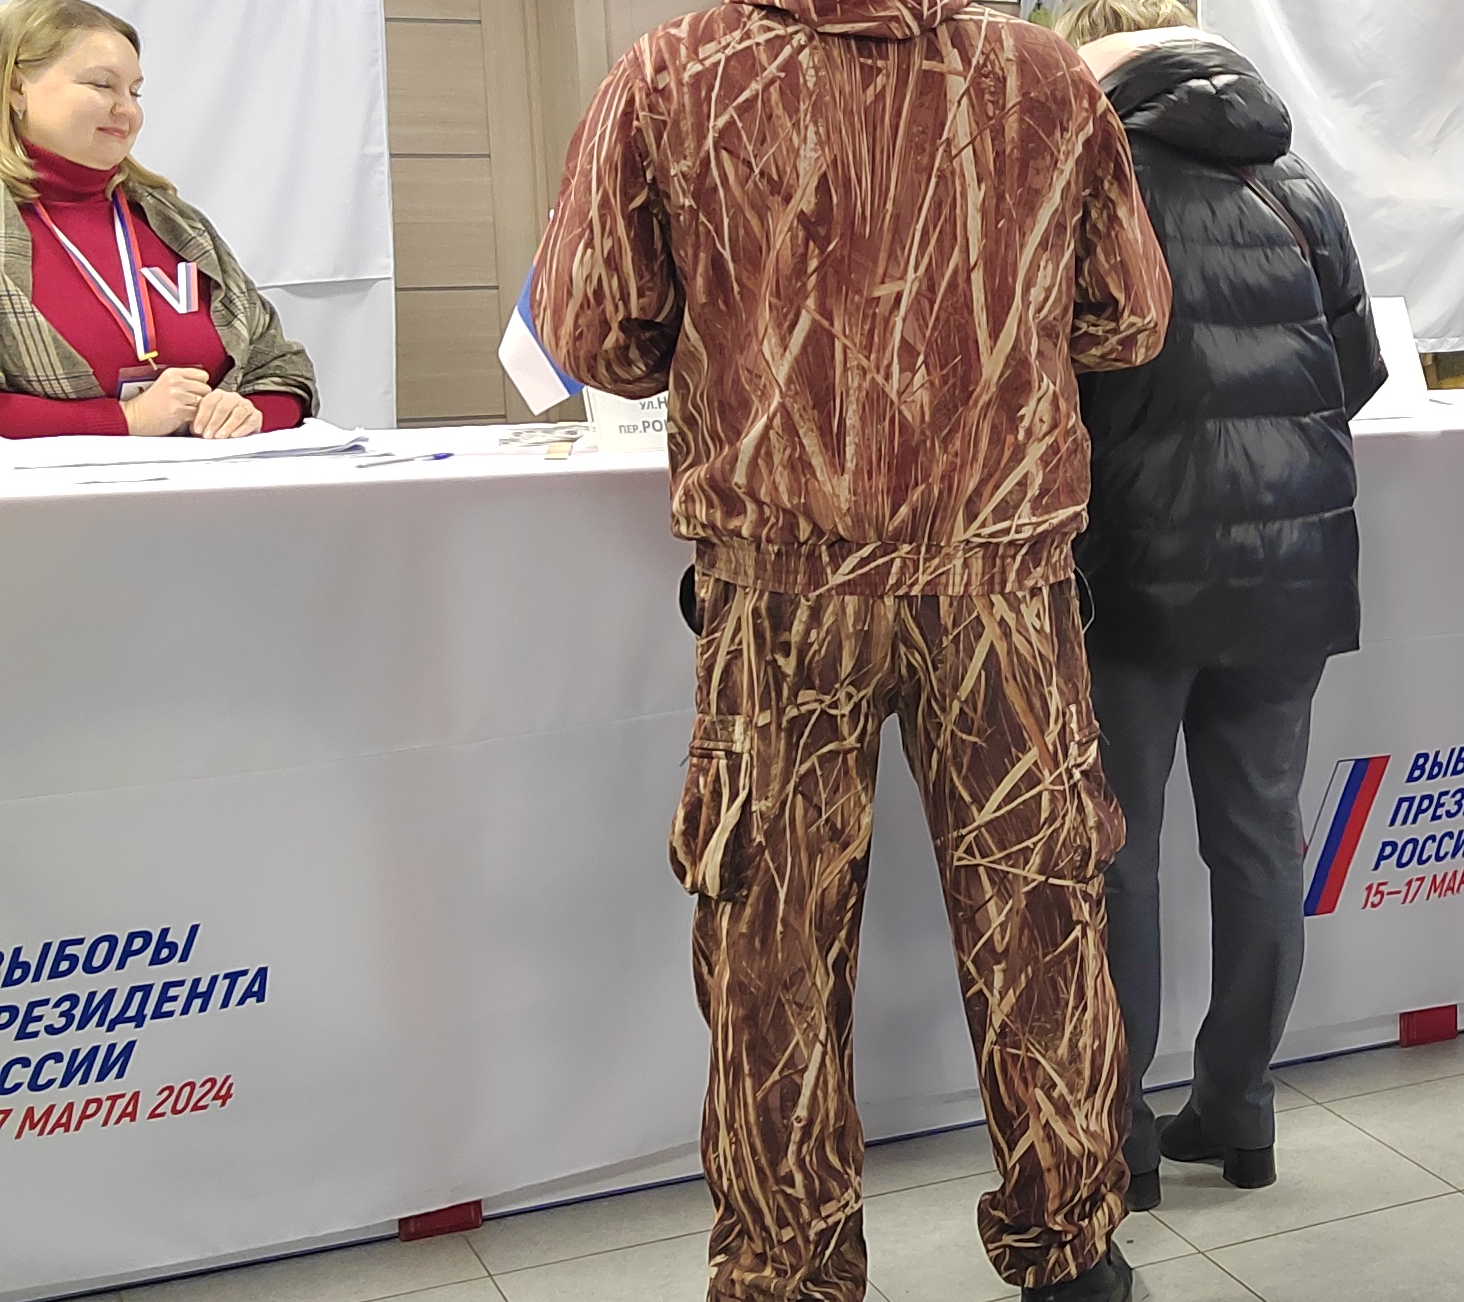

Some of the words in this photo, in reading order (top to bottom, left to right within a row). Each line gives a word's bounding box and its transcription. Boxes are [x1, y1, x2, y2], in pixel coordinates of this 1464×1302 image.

[618, 419, 668, 434] ПЕР.РО
[0, 923, 201, 989] ЫБОРЫ
[14, 1090, 141, 1141] МАРТА
[146, 1074, 235, 1121] 2024
